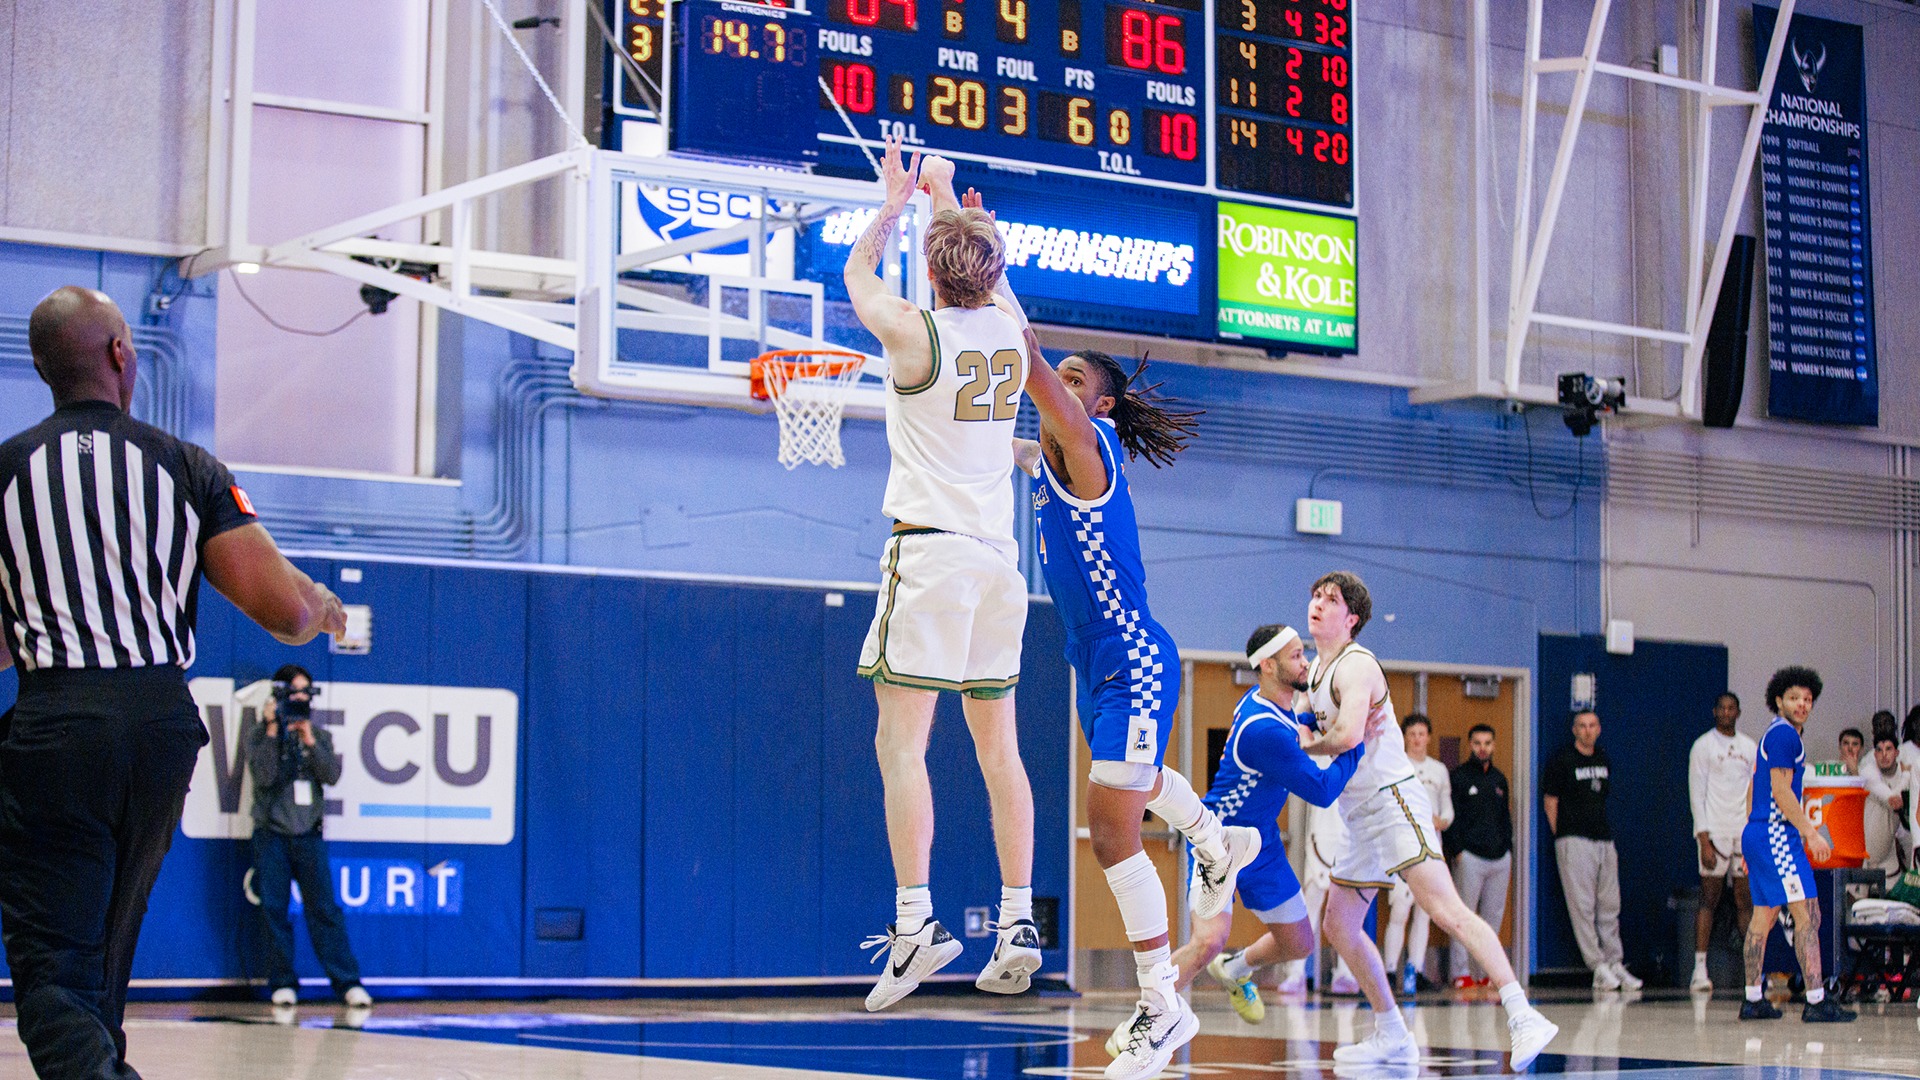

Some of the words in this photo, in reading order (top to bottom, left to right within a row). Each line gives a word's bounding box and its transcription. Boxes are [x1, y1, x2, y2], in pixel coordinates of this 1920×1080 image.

[946, 10, 963, 33] B
[1241, 0, 1257, 31] 3
[1284, 9, 1303, 37] 4
[1314, 11, 1347, 48] 32
[632, 24, 653, 62] 3
[712, 19, 786, 62] 14.7
[818, 28, 874, 57] FOULS
[1062, 29, 1079, 52] B
[1122, 9, 1186, 75] 86
[937, 47, 979, 73] PLYR
[997, 56, 1039, 82] FOUL
[1240, 41, 1257, 70] 4
[1285, 47, 1303, 80] 2
[1322, 55, 1348, 88] 10
[833, 64, 875, 114] 10
[1064, 66, 1095, 91] PTS
[902, 81, 914, 110] 1
[930, 76, 985, 130] 20
[1146, 80, 1196, 107] FOULS
[1230, 77, 1257, 108] 11
[1286, 85, 1303, 117] 2
[1331, 92, 1348, 125] 8
[1780, 92, 1843, 118] NATIONAL
[1003, 87, 1027, 136] 3
[1068, 97, 1095, 146] 6
[878, 119, 925, 145] T.O.L.
[1109, 109, 1130, 145] 0
[1160, 113, 1198, 161] 10
[1231, 119, 1257, 149] 14
[1286, 127, 1304, 156] 4
[1314, 129, 1349, 165] 20
[1786, 138, 1820, 153] SOFTBALL
[1098, 150, 1141, 176] T.O.L.
[1787, 157, 1820, 172] WOMEN'S
[1821, 162, 1849, 177] ROWING
[1787, 175, 1820, 190] WOMEN'S
[1822, 180, 1849, 195] ROWING
[1788, 194, 1820, 209] WOMEN'S
[1822, 199, 1849, 213] ROWING
[1788, 211, 1821, 228] WOMEN'S
[1823, 217, 1849, 232] ROWING
[1218, 213, 1355, 267] ROBINSON
[1789, 231, 1822, 246] WOMEN'S
[1824, 235, 1850, 250] ROWING
[1789, 249, 1823, 264] WOMEN'S
[1824, 254, 1850, 269] ROWING
[1284, 265, 1355, 309] KOLE
[1790, 268, 1823, 283] WOMEN'S
[1824, 272, 1850, 287] ROWING
[1790, 286, 1812, 300] MEN'S
[1813, 287, 1853, 306] BASKETBALL
[1218, 307, 1300, 333] ATTORNEYS
[1304, 318, 1323, 335] AT
[1326, 320, 1355, 338] LAW
[1790, 305, 1823, 320] WOMEN'S
[1825, 309, 1849, 324] SOCCER
[1790, 324, 1824, 339] WOMEN'S
[1825, 327, 1853, 342] ROWING
[1791, 342, 1825, 358] WOMEN'S
[1825, 346, 1851, 361] SOCCER
[1791, 361, 1825, 376] WOMEN'S
[1825, 365, 1855, 380] ROWING
[954, 349, 1022, 422] 22
